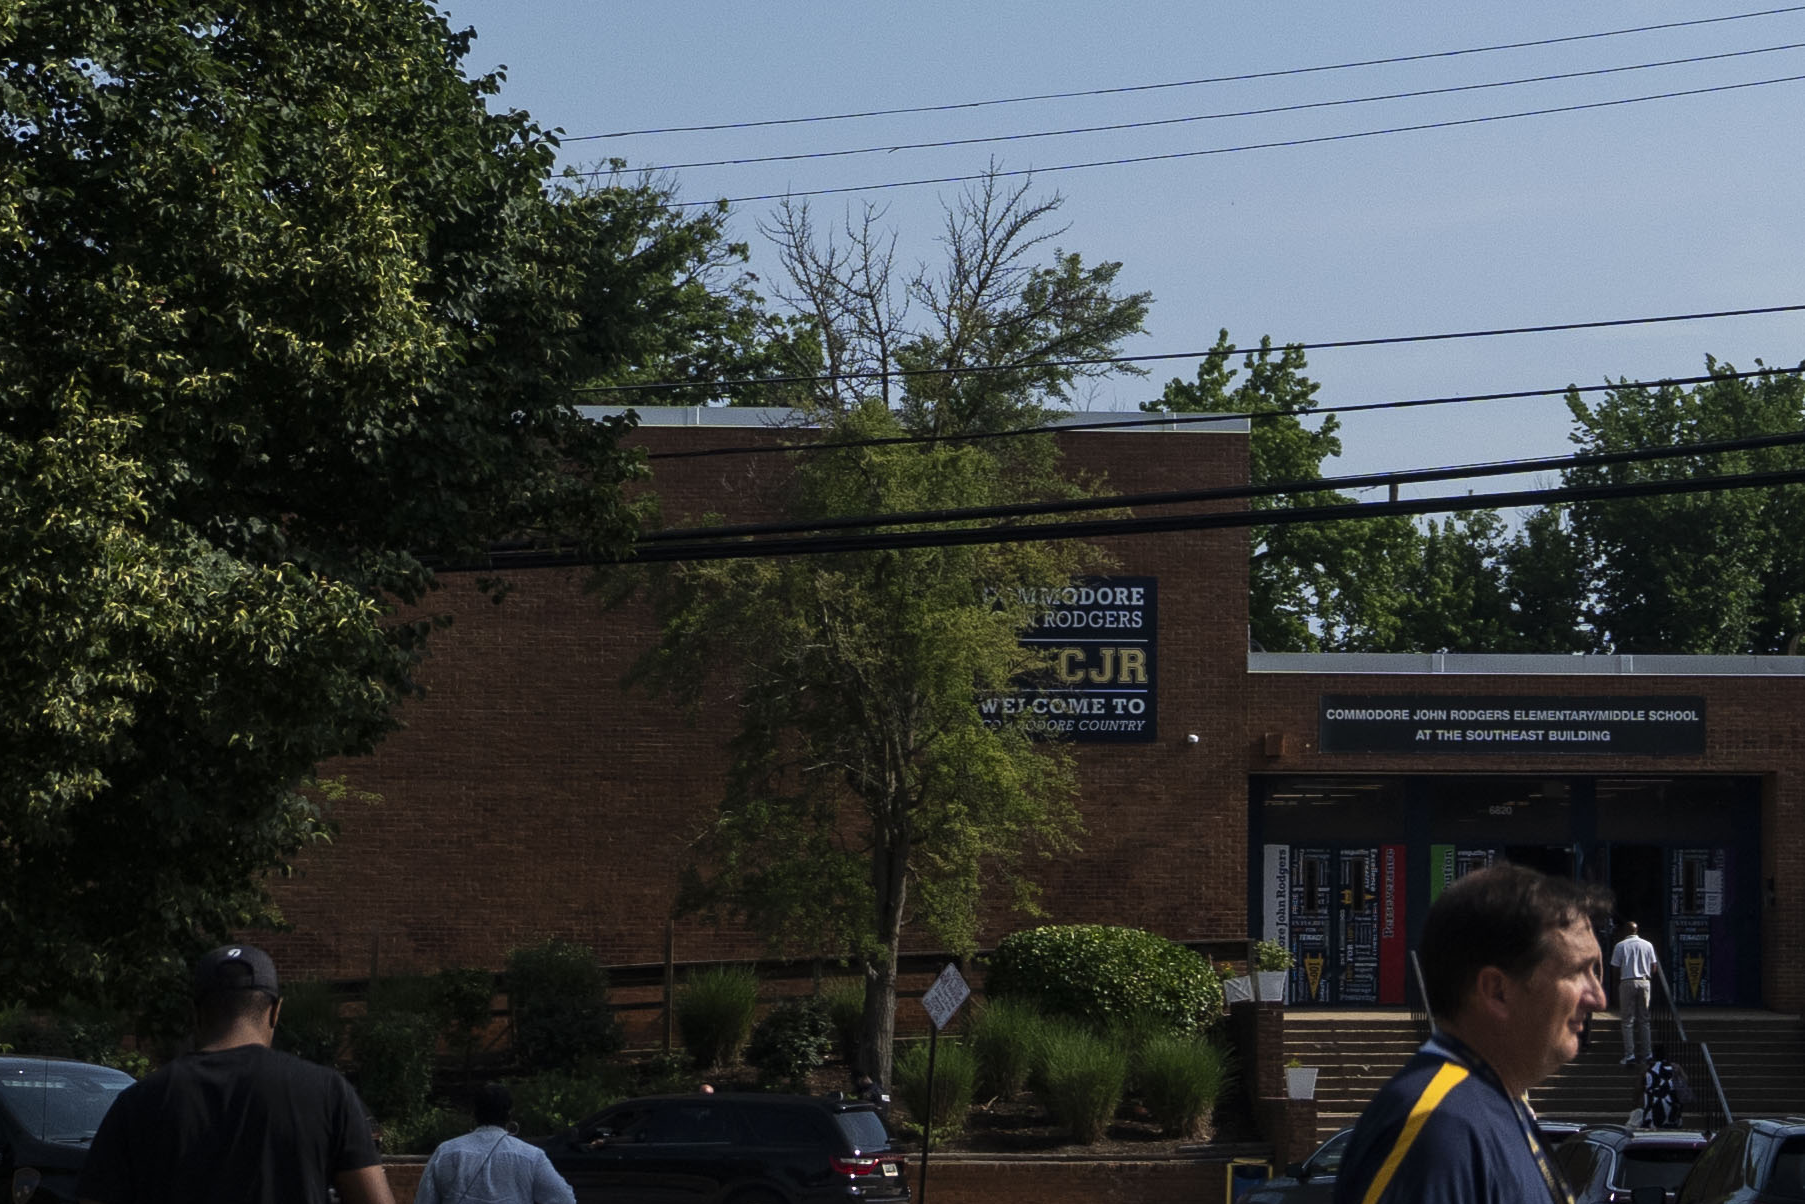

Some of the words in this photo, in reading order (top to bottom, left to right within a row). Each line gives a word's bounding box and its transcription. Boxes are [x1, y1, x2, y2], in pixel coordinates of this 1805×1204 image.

[982, 587, 1144, 605] CMMODORE
[1044, 611, 1143, 628] RODGERS
[1059, 647, 1148, 683] CJR
[1112, 698, 1145, 714] TO
[1326, 709, 1410, 721] COMMODORE
[1413, 709, 1447, 721] JOHN
[1450, 709, 1511, 721] RODGERS
[1513, 709, 1646, 721] ELEMENTARY/MIDDLE
[1648, 709, 1699, 721] SCHOOL
[1078, 720, 1146, 731] COUNTRY
[1415, 730, 1432, 741] AT
[1436, 730, 1463, 741] THE
[1465, 730, 1545, 741] SOUTHEAST
[1548, 730, 1611, 742] BUILDING
[1489, 805, 1512, 815] 6820
[1276, 849, 1290, 898] Rodgers
[1382, 848, 1395, 938] Perseverance
[1276, 899, 1289, 927] John
